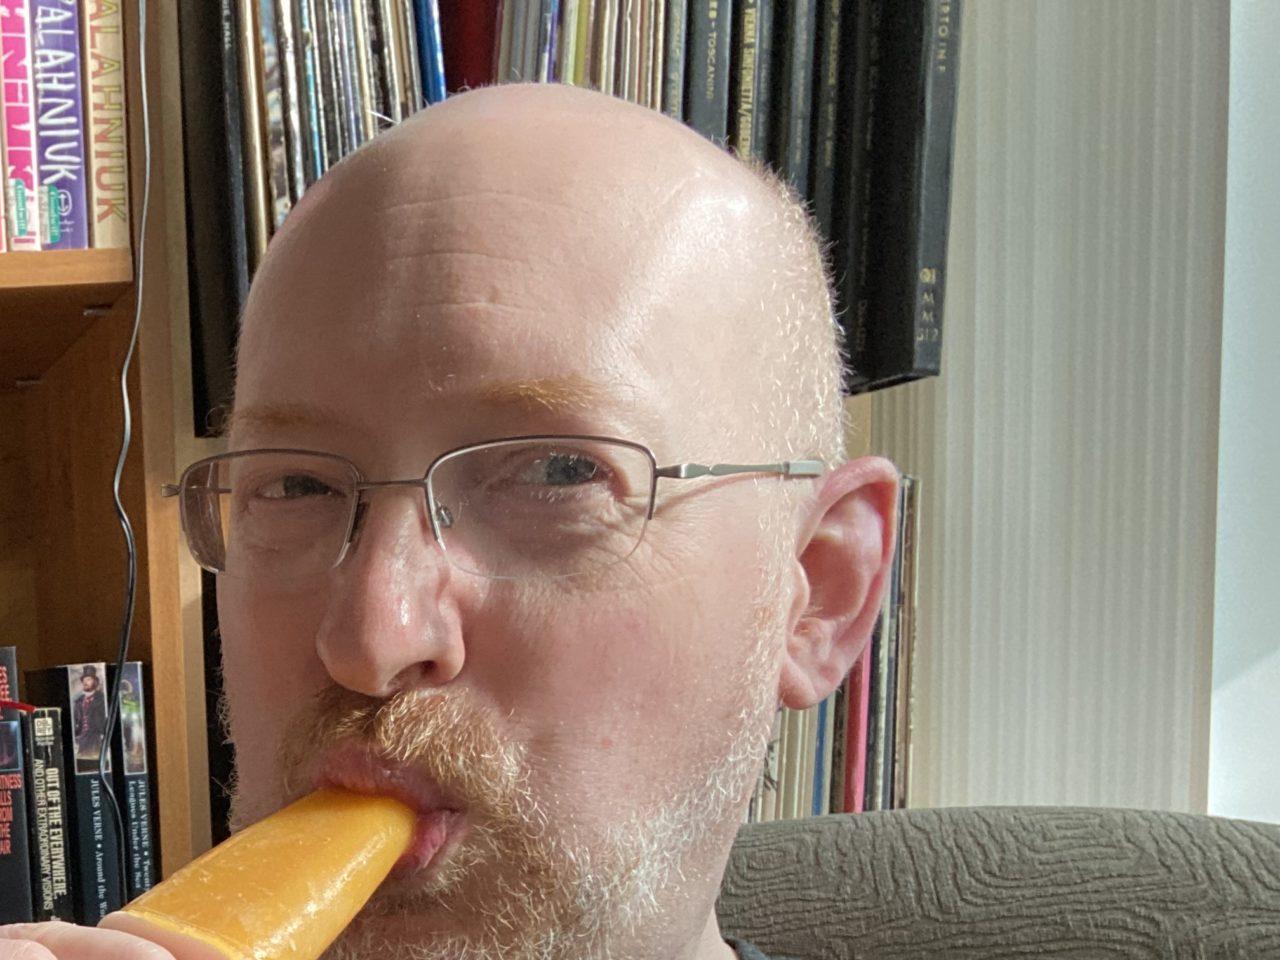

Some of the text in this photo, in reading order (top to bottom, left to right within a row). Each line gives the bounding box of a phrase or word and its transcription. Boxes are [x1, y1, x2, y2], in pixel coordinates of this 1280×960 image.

[35, 0, 83, 185] ALAHNIUK
[48, 803, 63, 826] THE
[89, 779, 105, 841] JULES VERNE
[127, 780, 140, 851] Leagues Under
